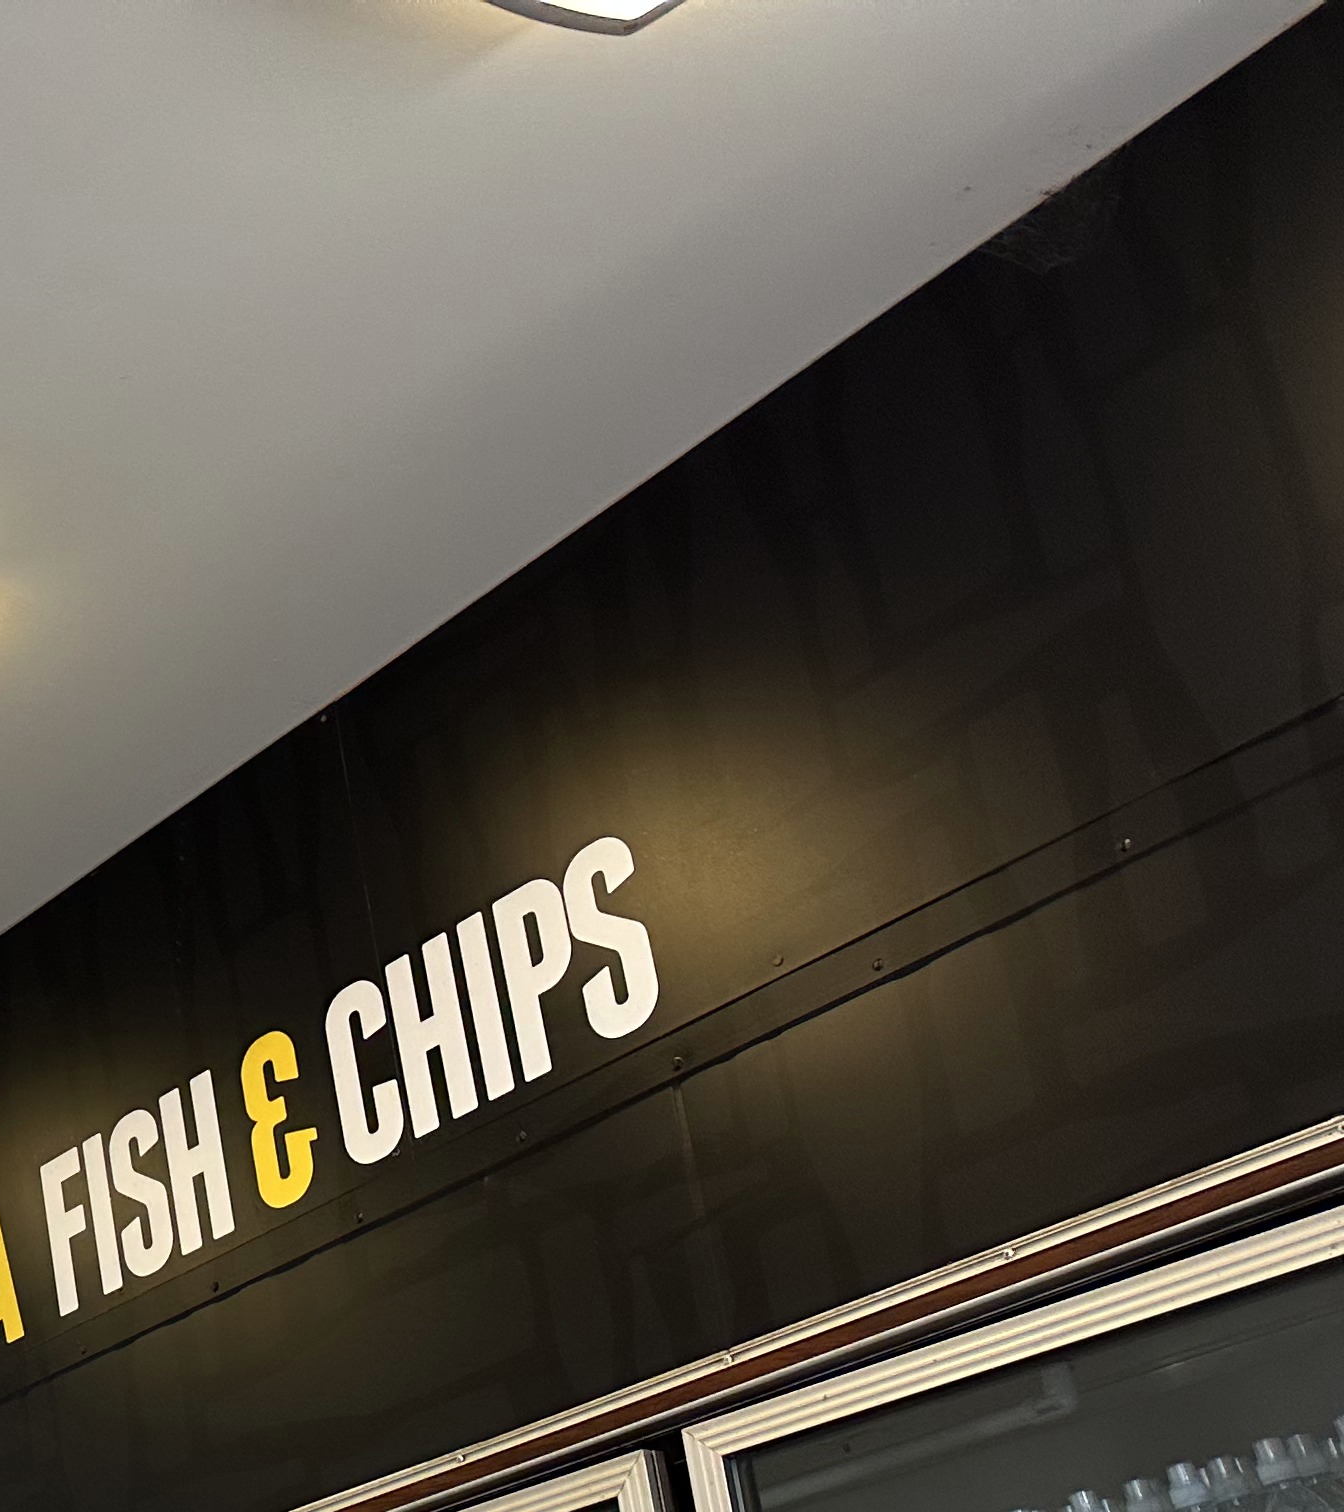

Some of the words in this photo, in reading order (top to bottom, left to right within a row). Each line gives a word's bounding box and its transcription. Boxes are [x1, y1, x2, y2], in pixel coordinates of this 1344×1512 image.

[40, 1070, 234, 1317] FISH
[241, 1030, 317, 1209] &
[325, 836, 660, 1164] CHIPS
